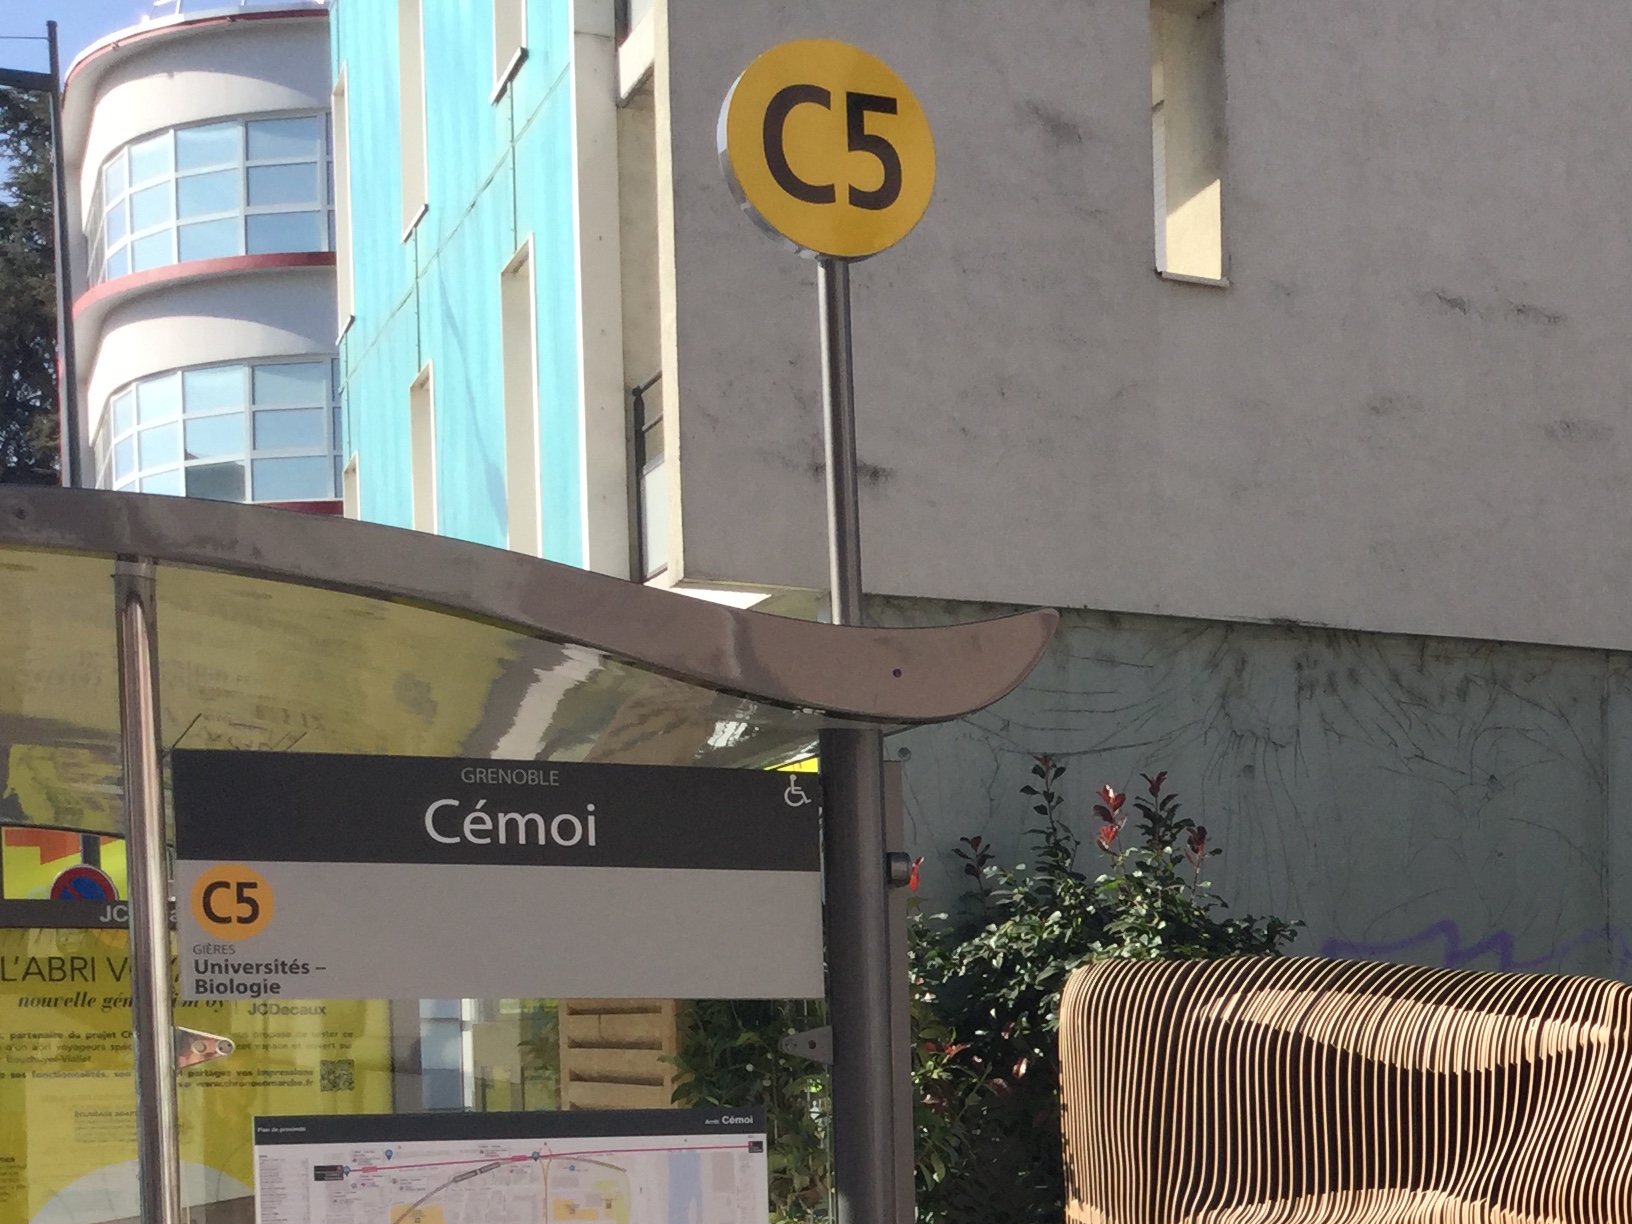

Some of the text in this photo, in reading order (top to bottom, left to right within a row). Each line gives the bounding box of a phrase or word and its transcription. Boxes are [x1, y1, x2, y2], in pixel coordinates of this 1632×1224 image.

[763, 84, 902, 211] C5
[461, 767, 559, 787] GRENOBLE
[424, 798, 597, 847] Cémoi
[202, 880, 260, 924] C5
[193, 943, 236, 955] GIÈRES
[193, 958, 311, 975] Universités
[195, 978, 282, 998] Biologie
[18, 991, 97, 1008] nouvelle
[247, 1002, 327, 1016] JCDecaux
[86, 1030, 116, 1041] projet
[721, 1115, 754, 1125] Cémoi
